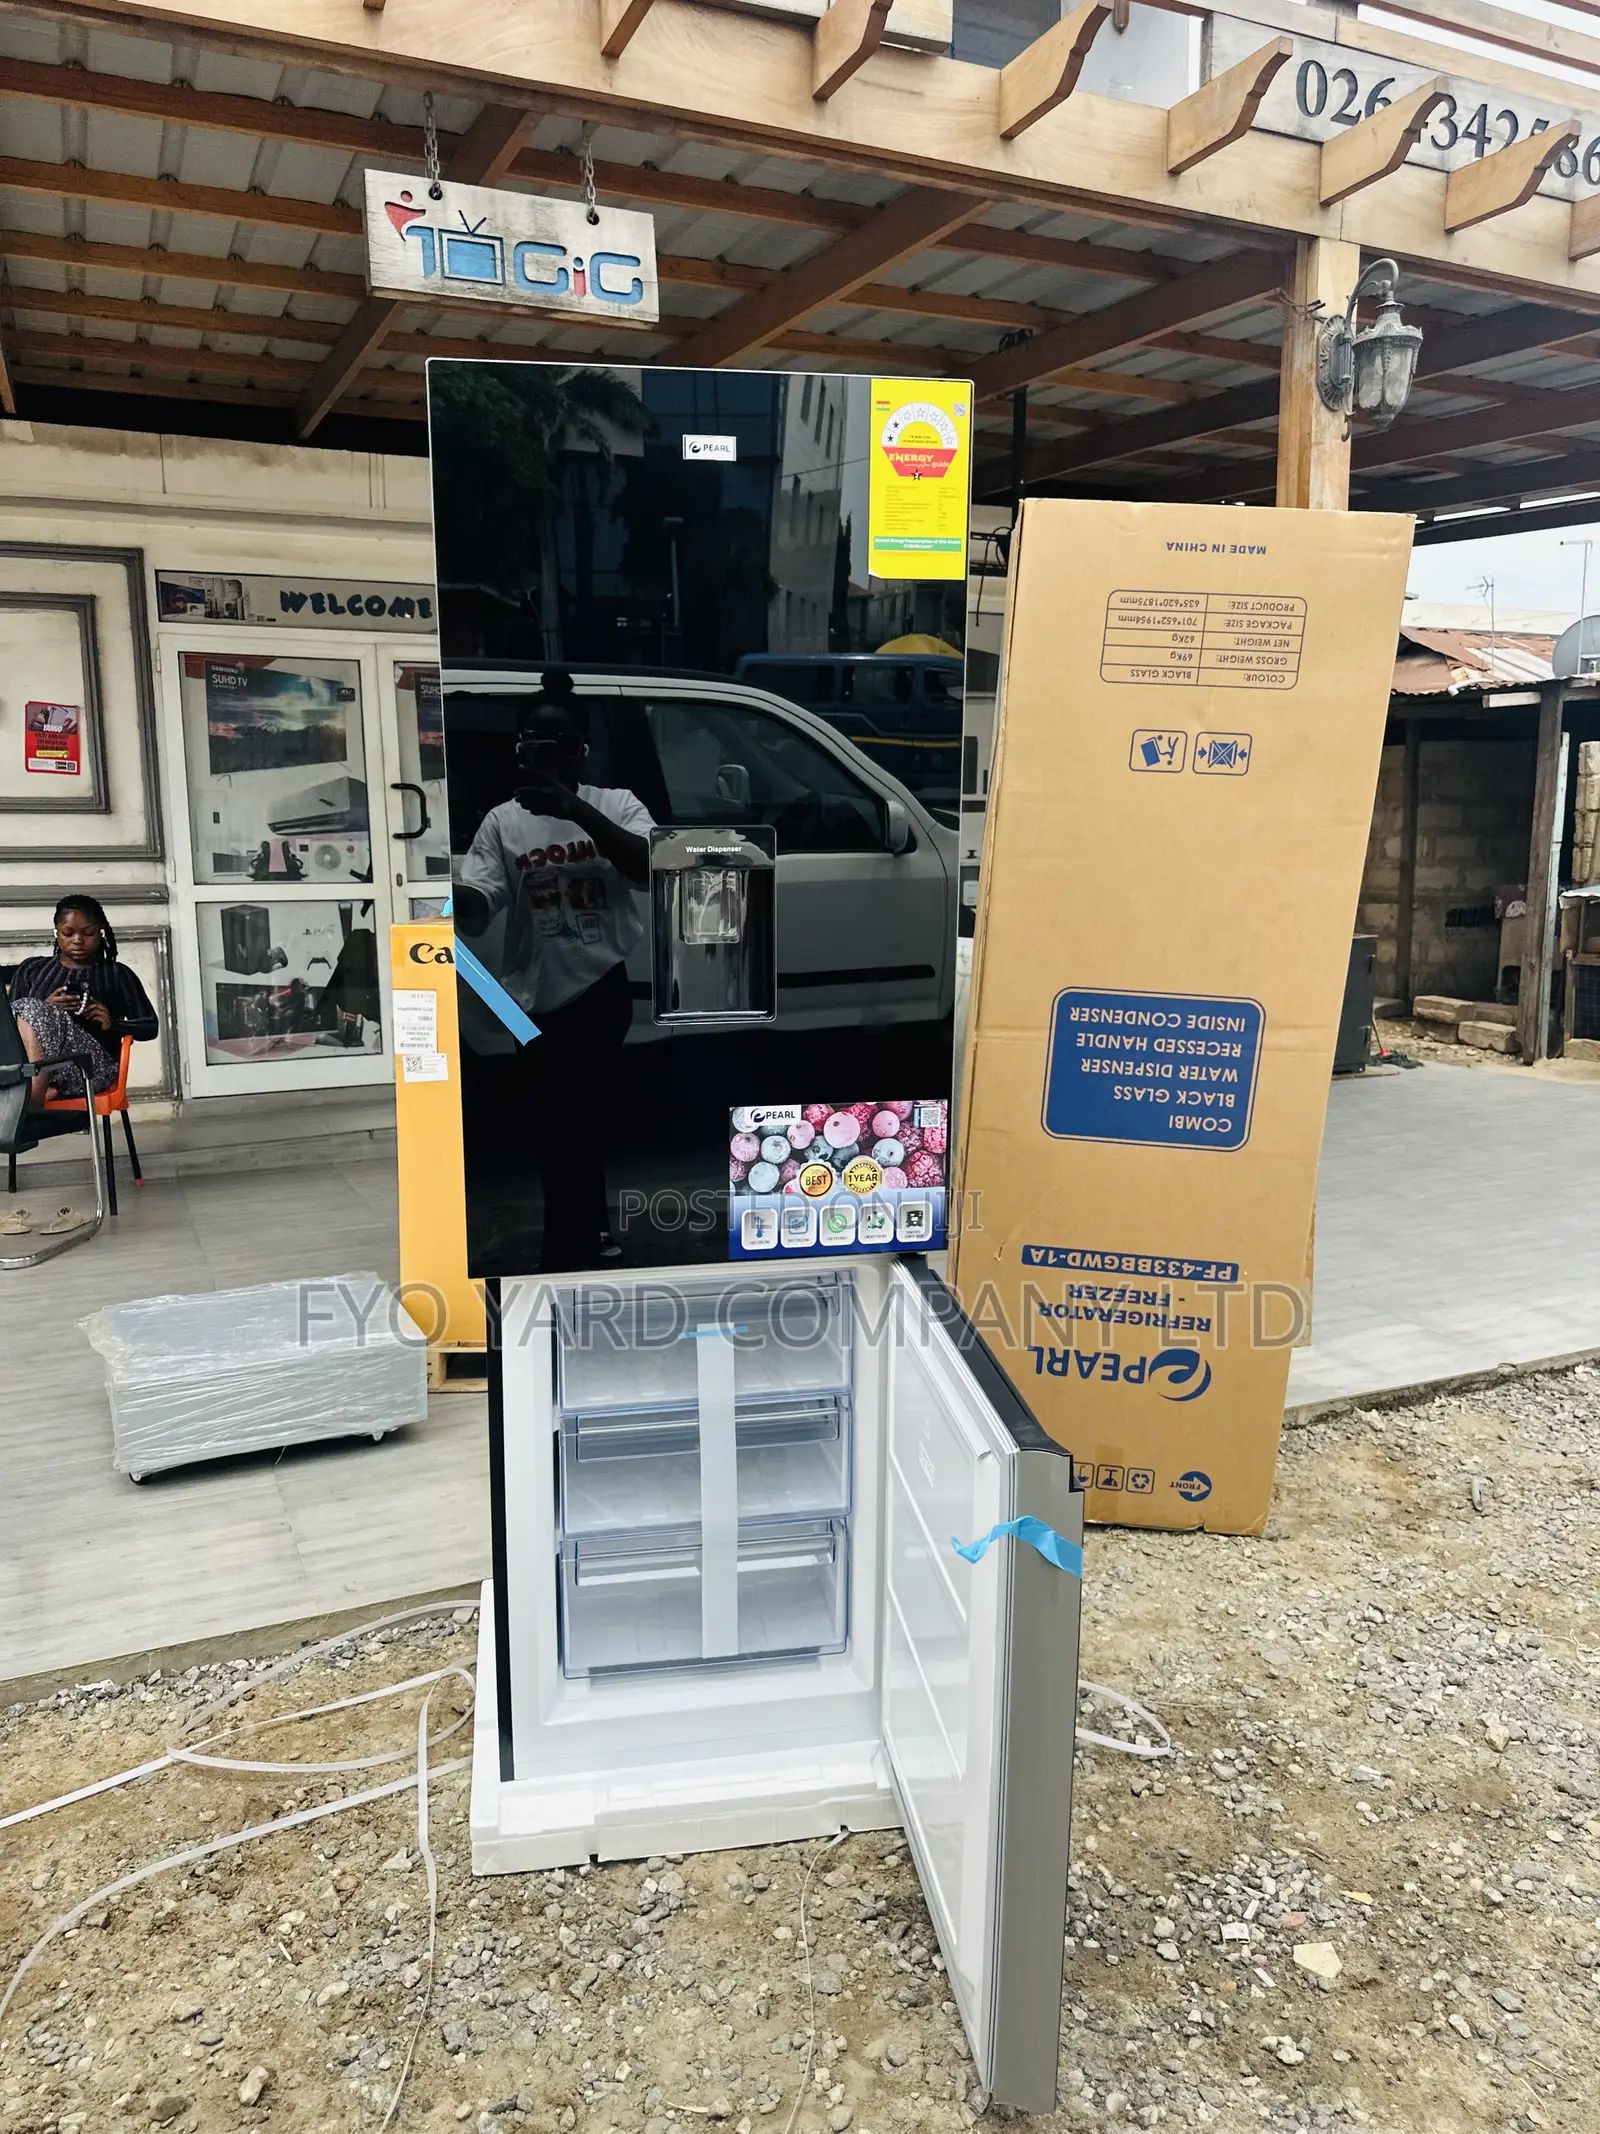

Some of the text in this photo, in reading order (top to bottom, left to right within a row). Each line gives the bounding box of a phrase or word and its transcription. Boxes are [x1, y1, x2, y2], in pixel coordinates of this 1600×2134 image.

[703, 444, 731, 453] PEARL
[888, 453, 934, 463] ENERGY
[1166, 542, 1266, 554] MADE IN CHINA
[280, 590, 433, 619] WELCOME
[1228, 601, 1295, 612] PRODUCT SIZE:
[1224, 619, 1293, 630] PACKAGE SIZE:
[1172, 634, 1195, 644] 62Kg
[1233, 637, 1290, 648] NET WEIGHT:
[1170, 651, 1193, 661] 69Kg
[1216, 654, 1288, 665] GROSS WEIGHT:
[1130, 668, 1192, 679] BLACK GLASS
[1243, 673, 1285, 683] COLOUR:
[237, 677, 248, 686] TV
[707, 845, 742, 854] Dispenser
[1069, 1007, 1246, 1032] INSIDE CONDENSER
[1076, 1033, 1242, 1057] RECESSED HANDLE
[1081, 1058, 1238, 1083] WATER DISPENSER
[1113, 1085, 1236, 1108] BLACK GLASS
[765, 1110, 796, 1120] PEARL
[1168, 1115, 1232, 1133] COMBI
[805, 1175, 828, 1186] BEST
[853, 1174, 878, 1182] YEAR
[1030, 1248, 1232, 1281] PF-433BBGWD-1A
[1068, 1284, 1171, 1307] FREEZER
[1038, 1302, 1212, 1332] REFRIGERATOR
[1027, 1345, 1147, 1384] PEARL
[1169, 1481, 1201, 1490] FRONT
